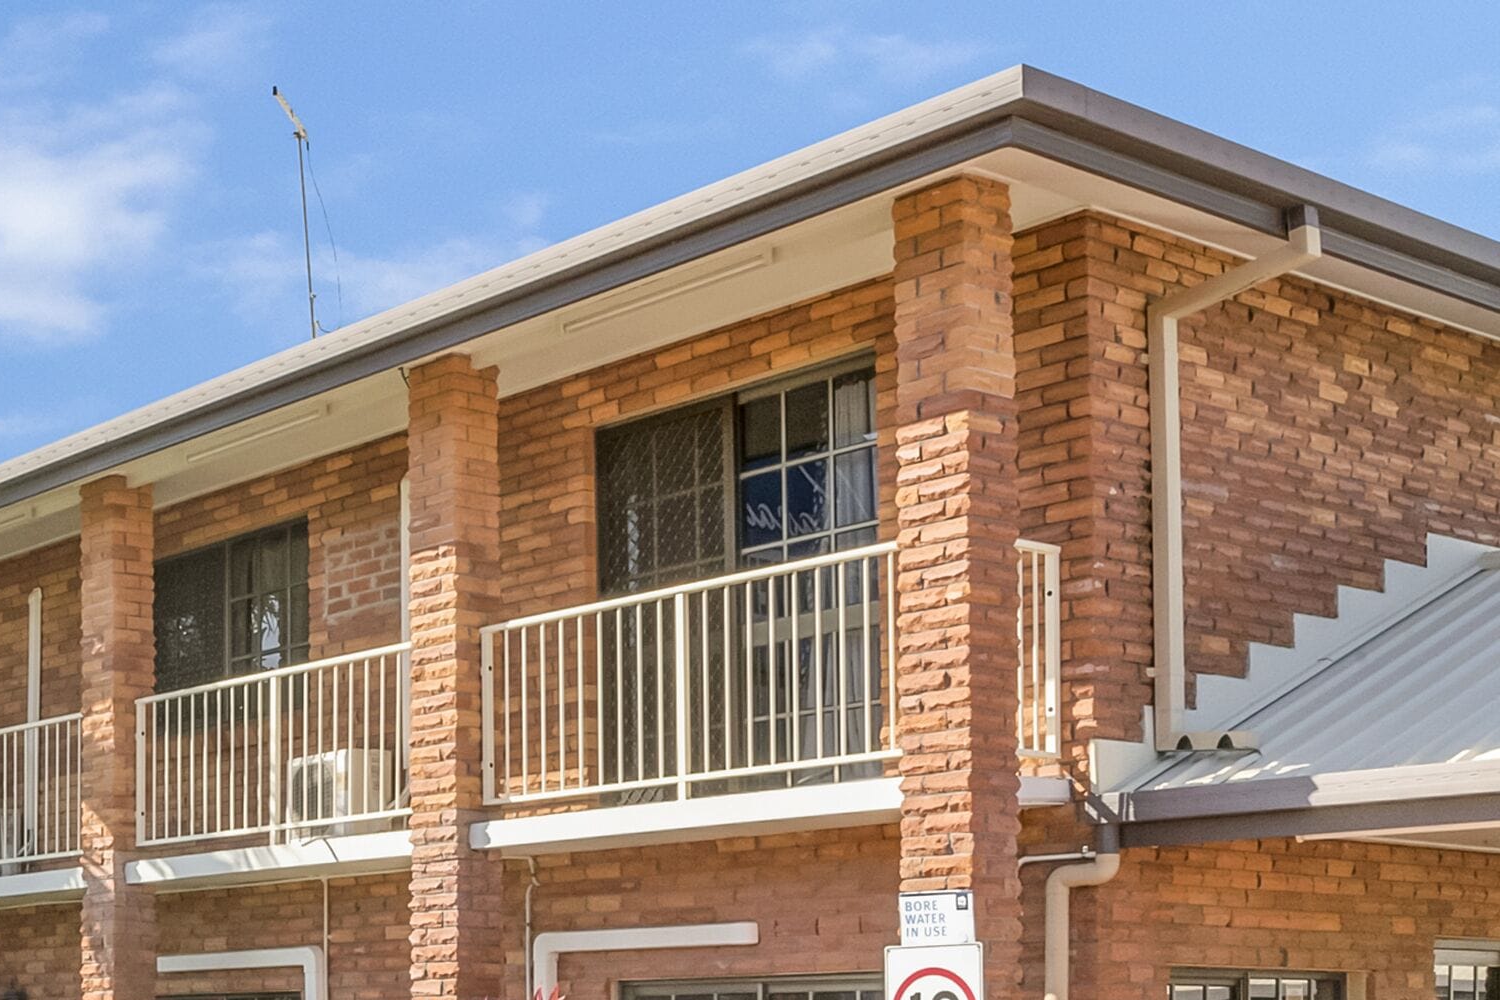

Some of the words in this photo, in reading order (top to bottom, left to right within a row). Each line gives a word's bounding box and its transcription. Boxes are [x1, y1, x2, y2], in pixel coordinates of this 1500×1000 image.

[905, 900, 938, 911] BORE
[905, 913, 946, 924] WATER
[906, 927, 919, 937] IN
[924, 926, 947, 937] USE
